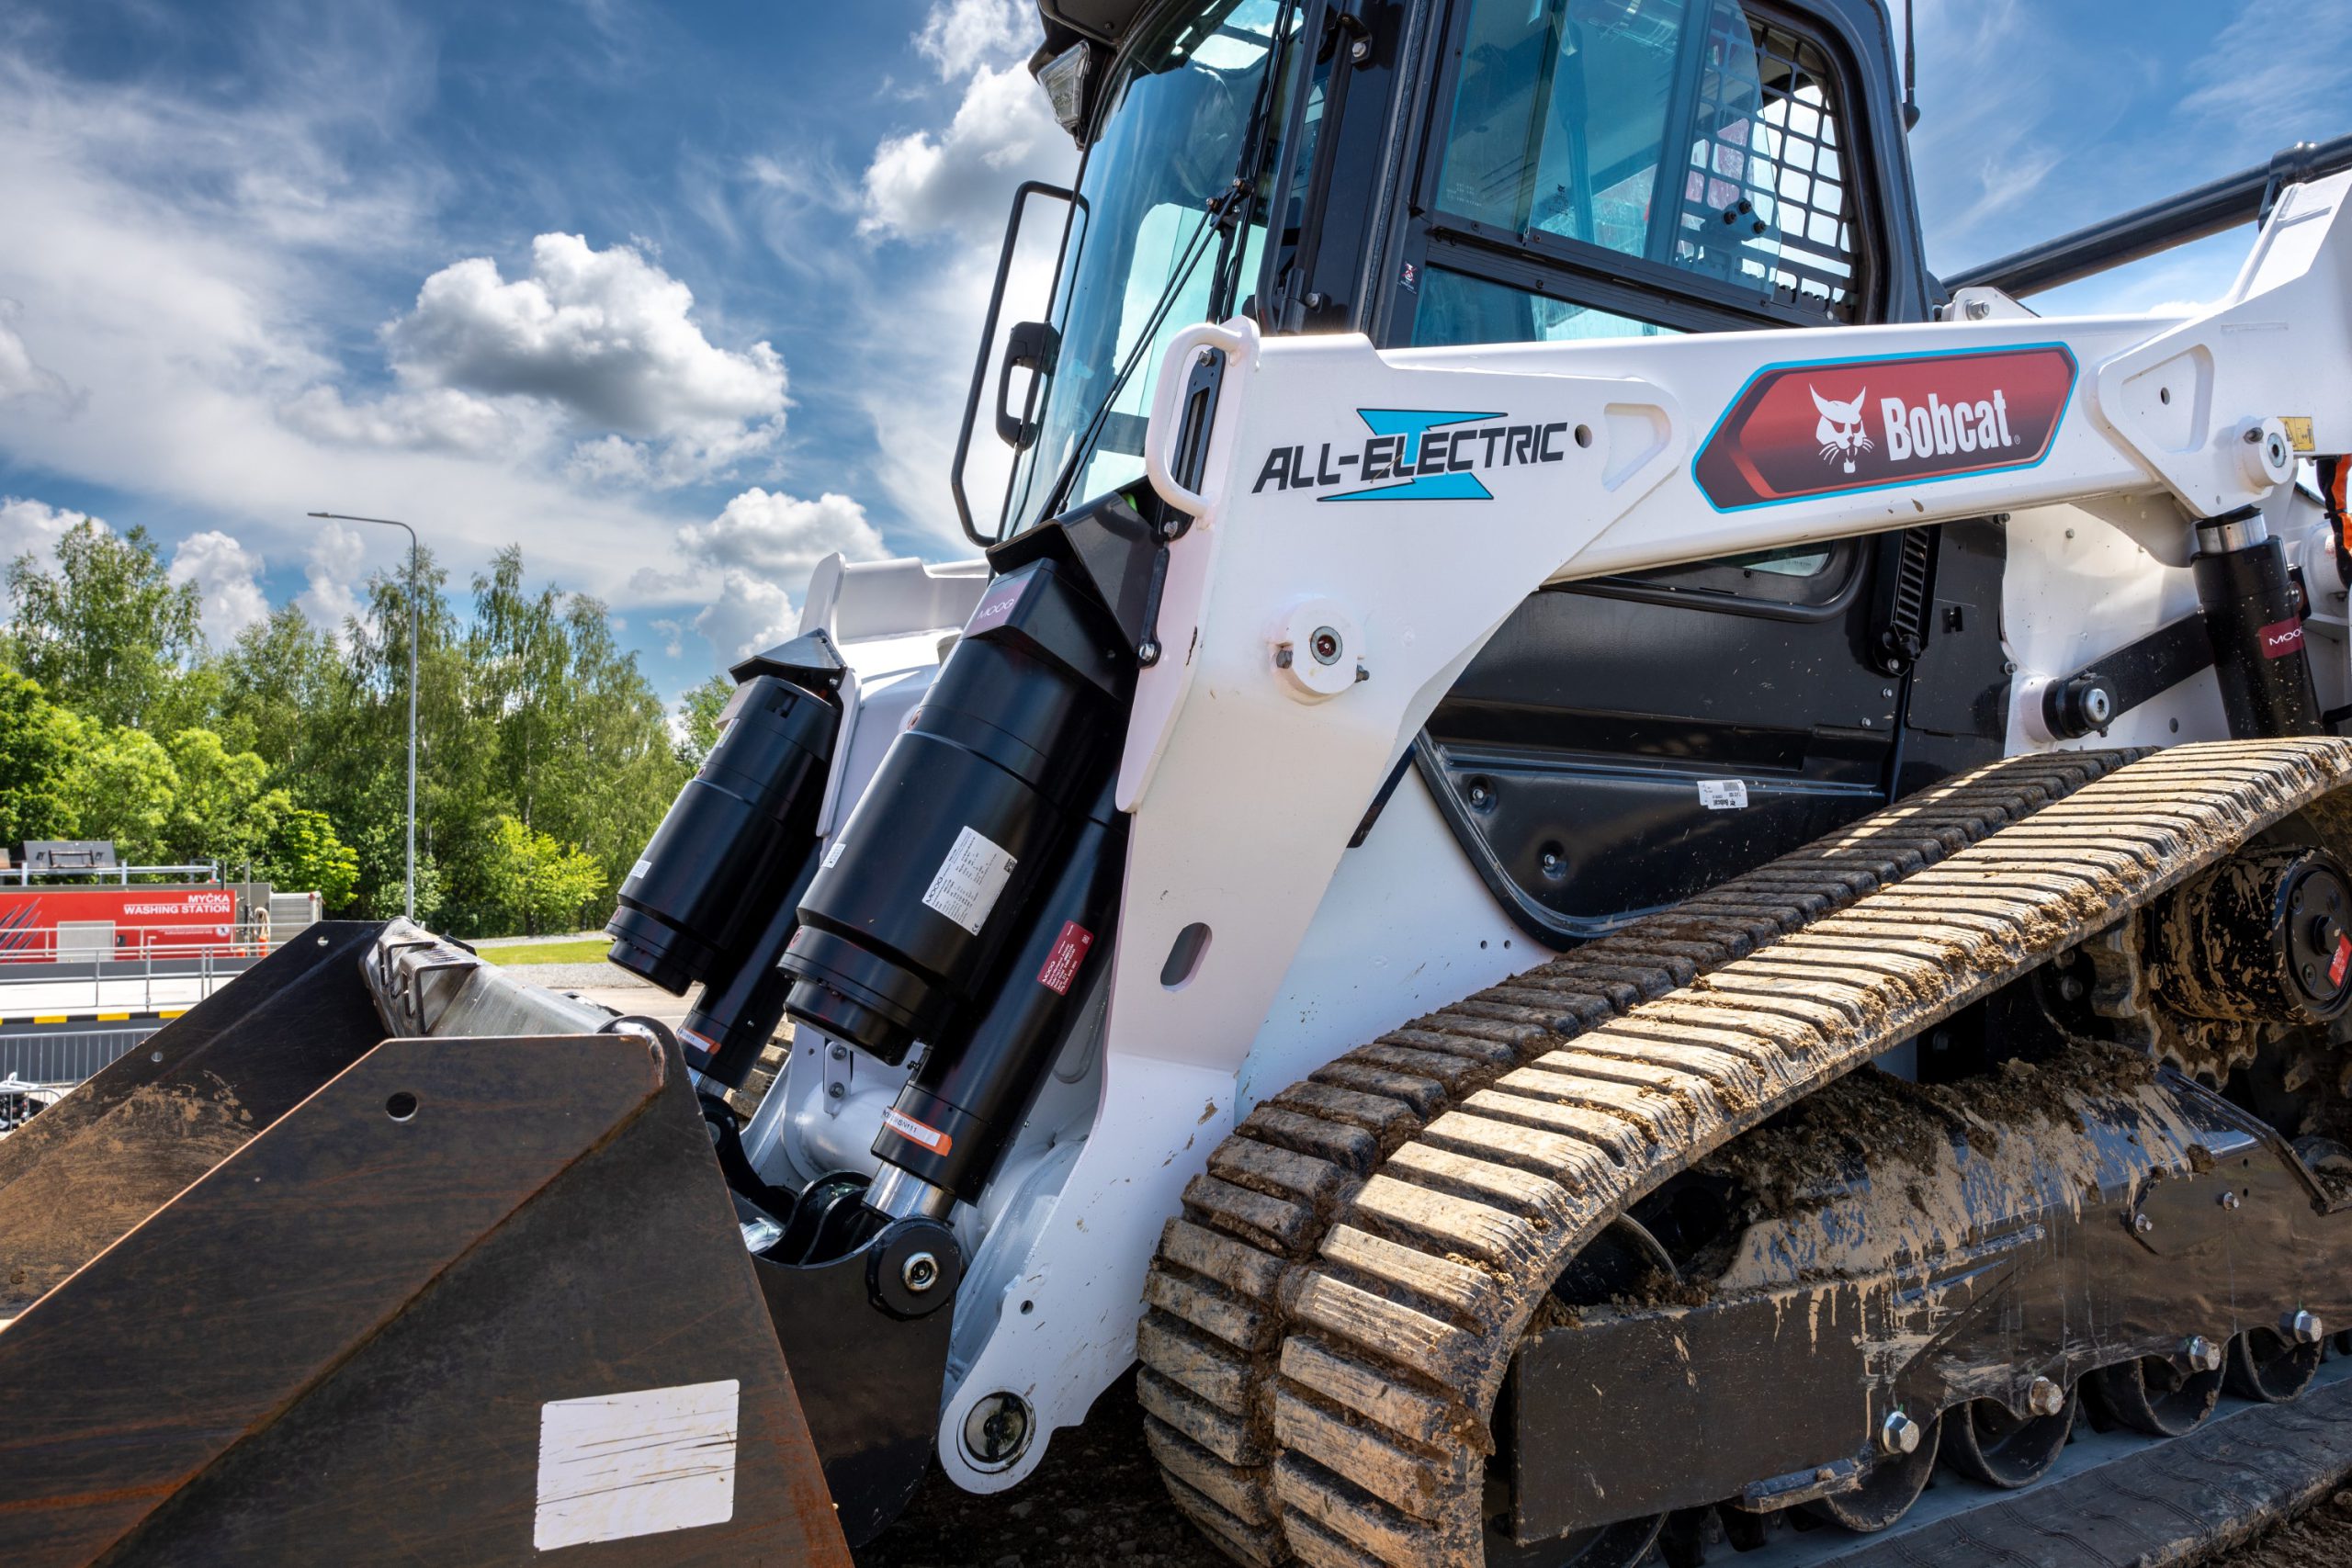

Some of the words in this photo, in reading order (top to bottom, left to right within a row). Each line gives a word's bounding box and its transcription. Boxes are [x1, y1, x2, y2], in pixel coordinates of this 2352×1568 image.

[1881, 389, 2012, 461] Bobcat
[1251, 422, 1568, 494] ALL-ELECTRIC
[978, 599, 1014, 618] MOOG
[188, 893, 230, 903] MYČKA
[926, 876, 943, 903] MOOG
[124, 905, 178, 915] WASHING
[182, 905, 230, 913] STATION
[1042, 961, 1056, 983] MOOG
